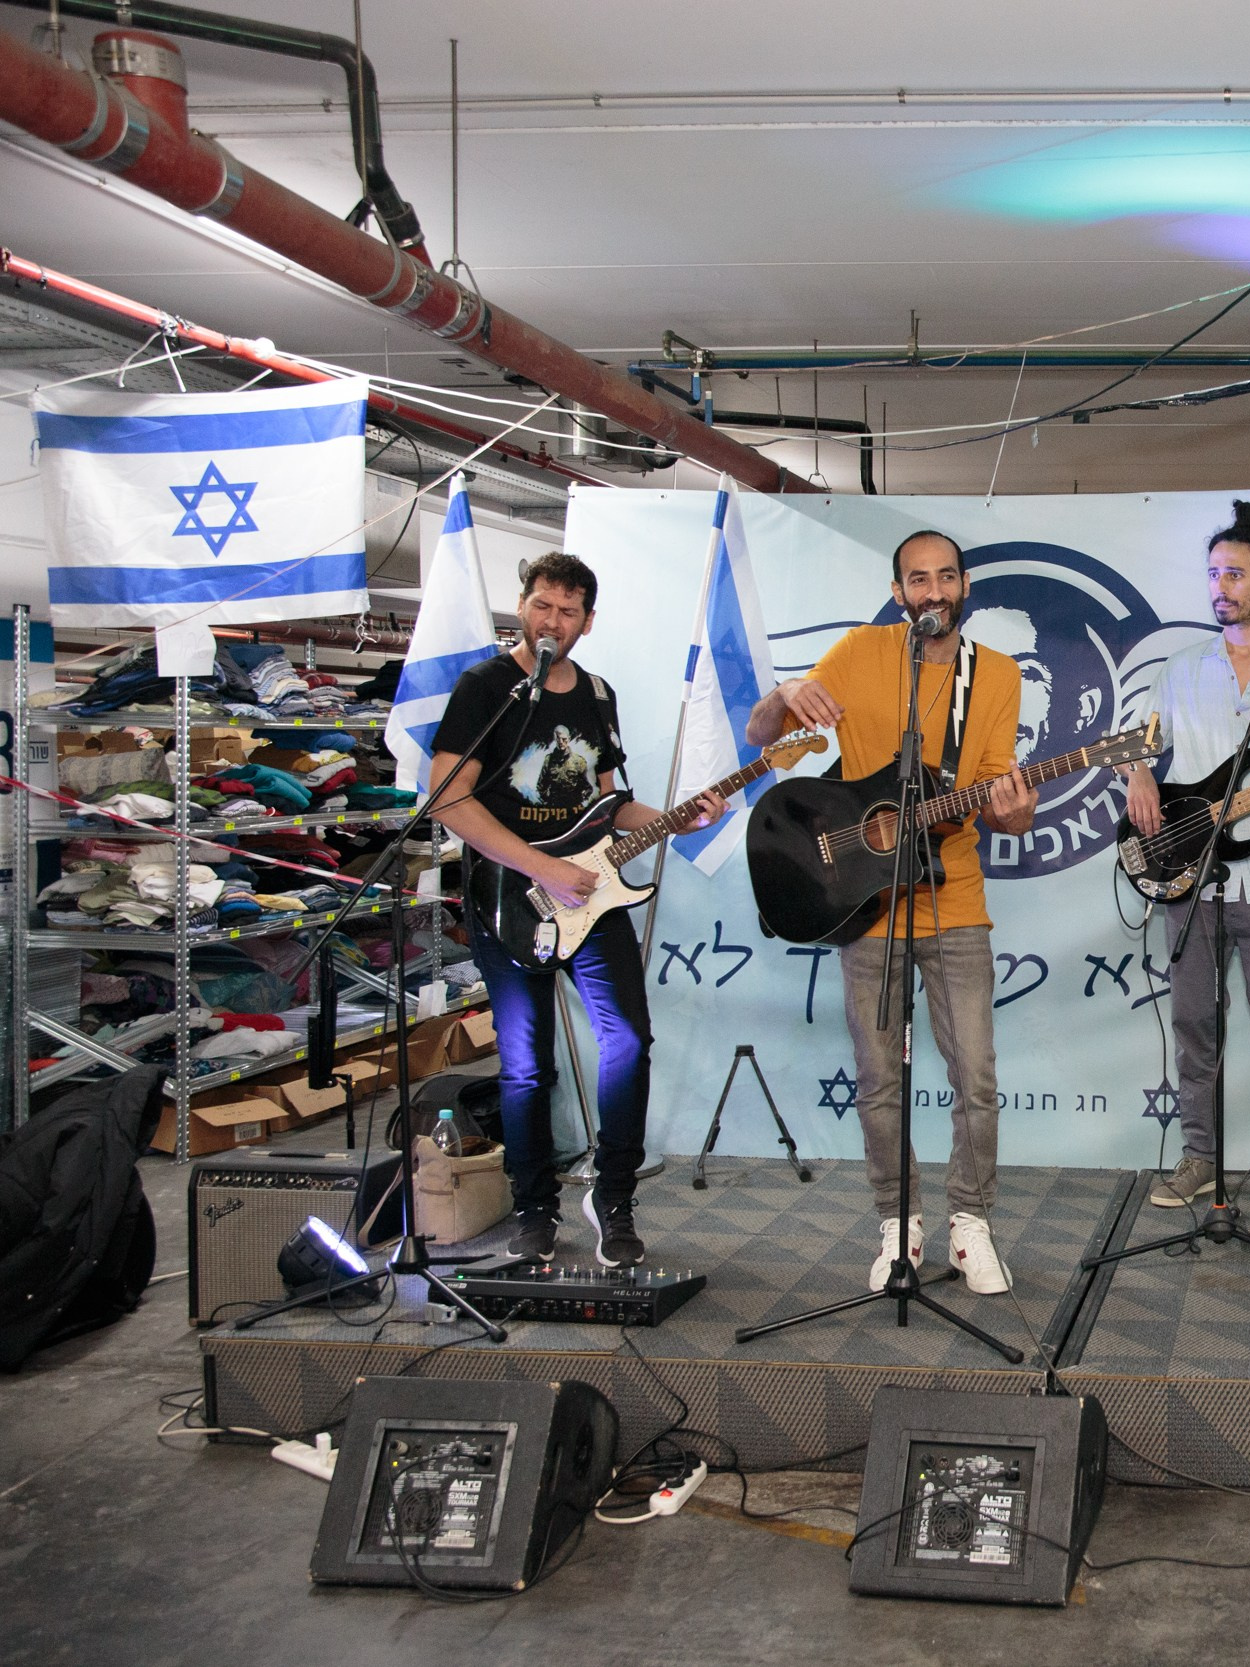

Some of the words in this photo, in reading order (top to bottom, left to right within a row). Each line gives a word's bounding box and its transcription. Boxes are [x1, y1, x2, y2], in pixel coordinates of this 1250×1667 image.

[520, 806, 568, 823] מיקום
[915, 1086, 953, 1108] שמ
[1075, 1092, 1107, 1112] חג
[612, 1289, 642, 1297] HELIX
[449, 1478, 482, 1488] ALTO
[980, 1493, 1013, 1504] ALTO
